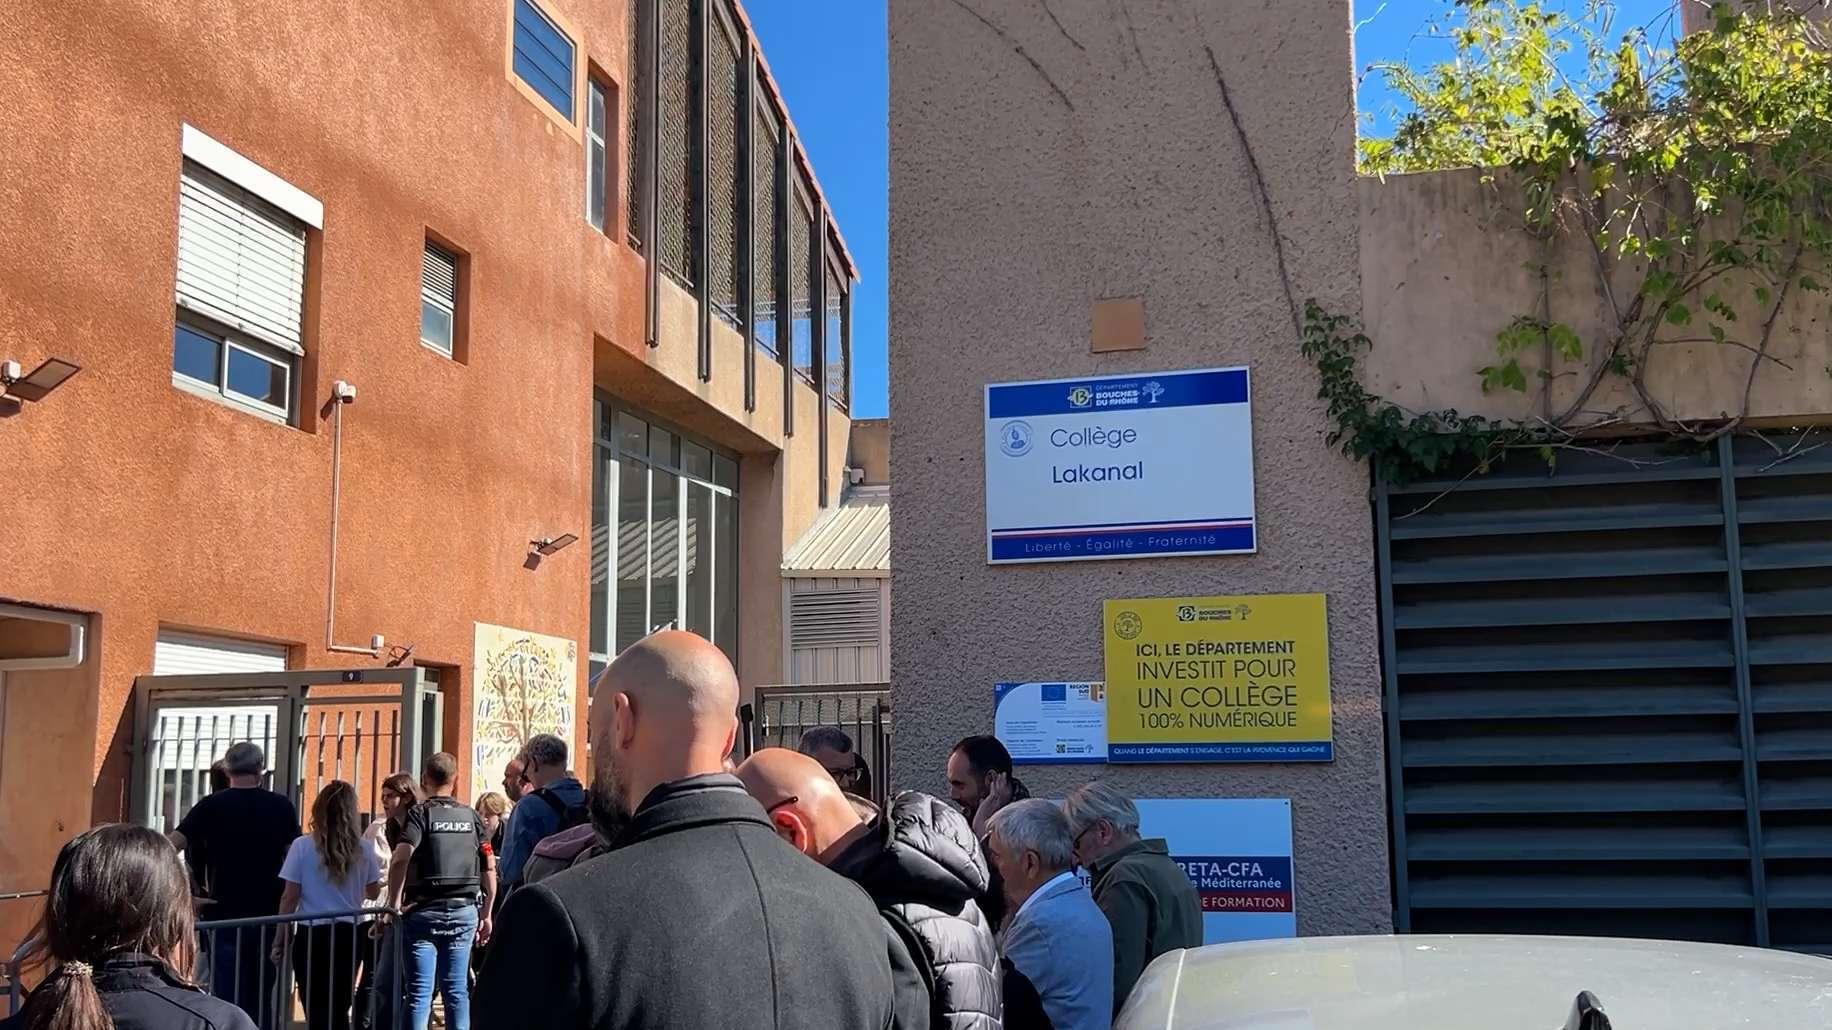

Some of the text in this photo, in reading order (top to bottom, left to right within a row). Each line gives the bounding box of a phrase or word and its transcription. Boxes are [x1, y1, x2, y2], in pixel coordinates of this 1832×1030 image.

[1050, 426, 1137, 448] Collège
[1053, 461, 1144, 483] Lakanal
[1026, 541, 1071, 553] Liberté
[1086, 538, 1133, 553] Égalité
[1148, 535, 1216, 548] Fraternité
[1136, 639, 1295, 658] ICI, LE DÉPARTEMENT
[1137, 659, 1296, 680] INVESTIT POUR
[1138, 681, 1297, 708] UN COLLÈGE
[1139, 709, 1297, 729] 100% NUMÉRIQUE
[434, 821, 472, 831] POLICE
[1203, 877, 1281, 888] Méditerranée
[1200, 897, 1284, 908] E FORMATION
